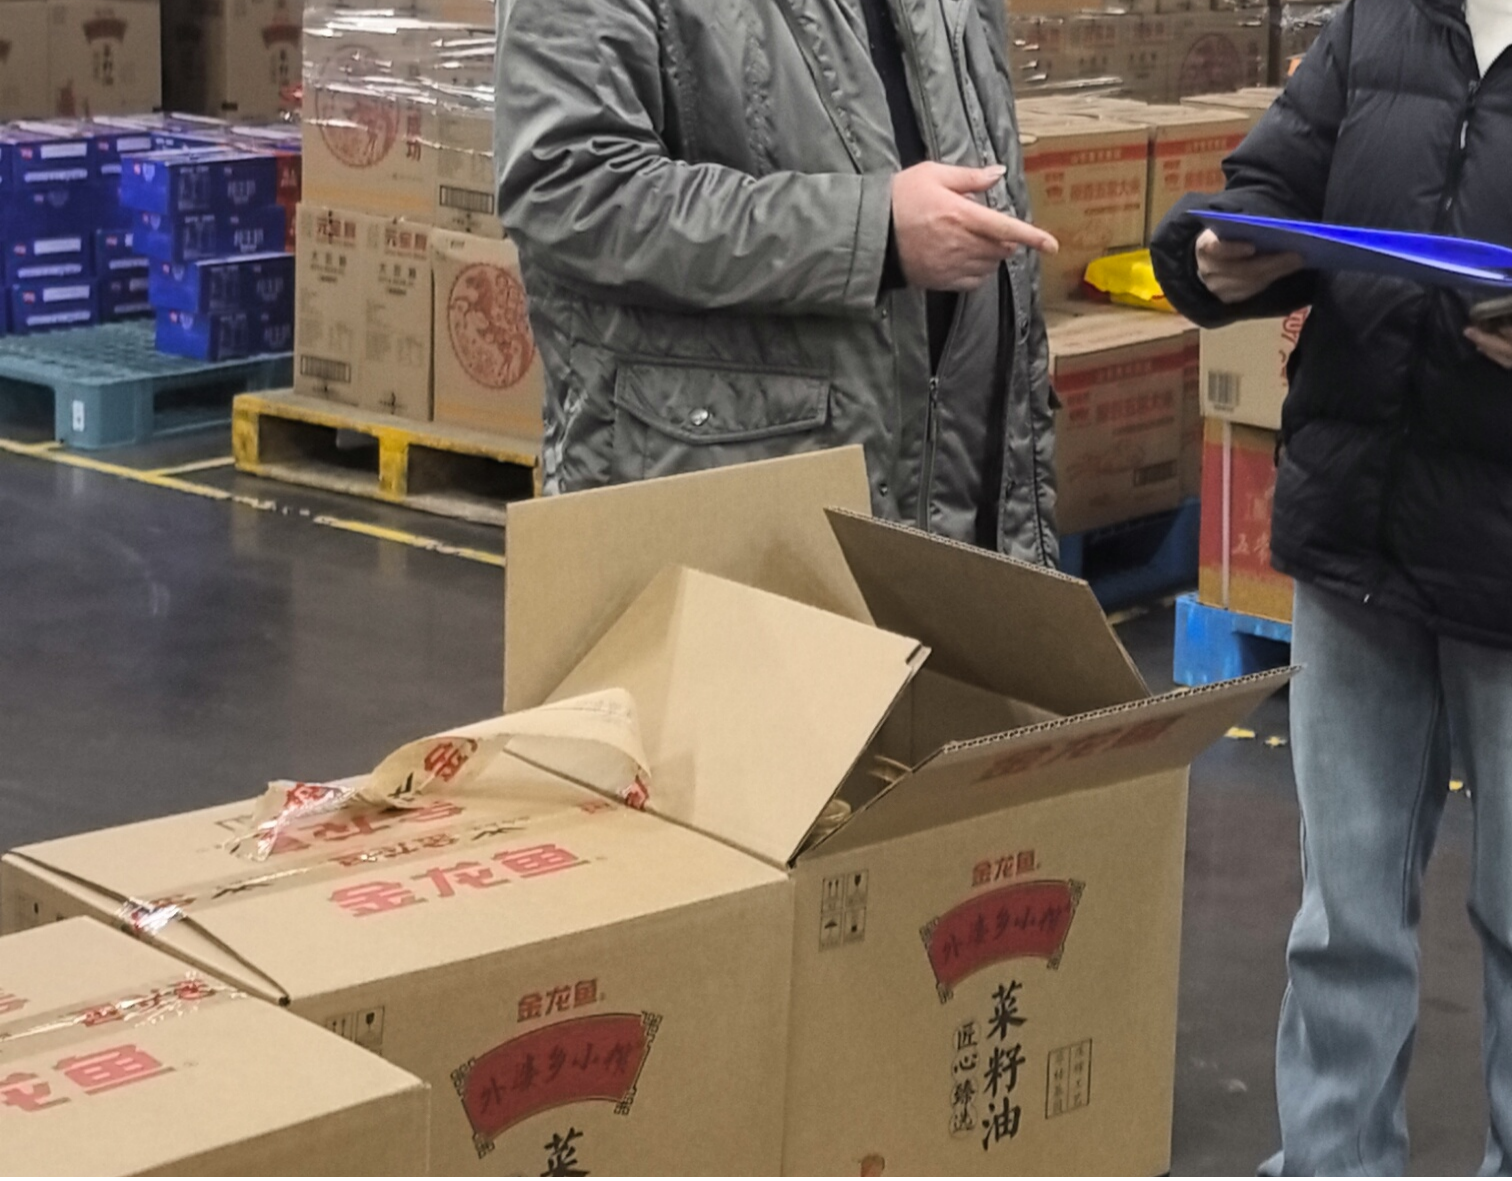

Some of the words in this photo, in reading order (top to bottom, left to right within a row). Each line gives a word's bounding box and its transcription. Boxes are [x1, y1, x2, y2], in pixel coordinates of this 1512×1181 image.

[327, 842, 592, 917] 金龙鱼
[971, 849, 1036, 886] 金龙鱼
[516, 978, 598, 1023] 金龙鱼
[982, 980, 1027, 1152] 菜籽油
